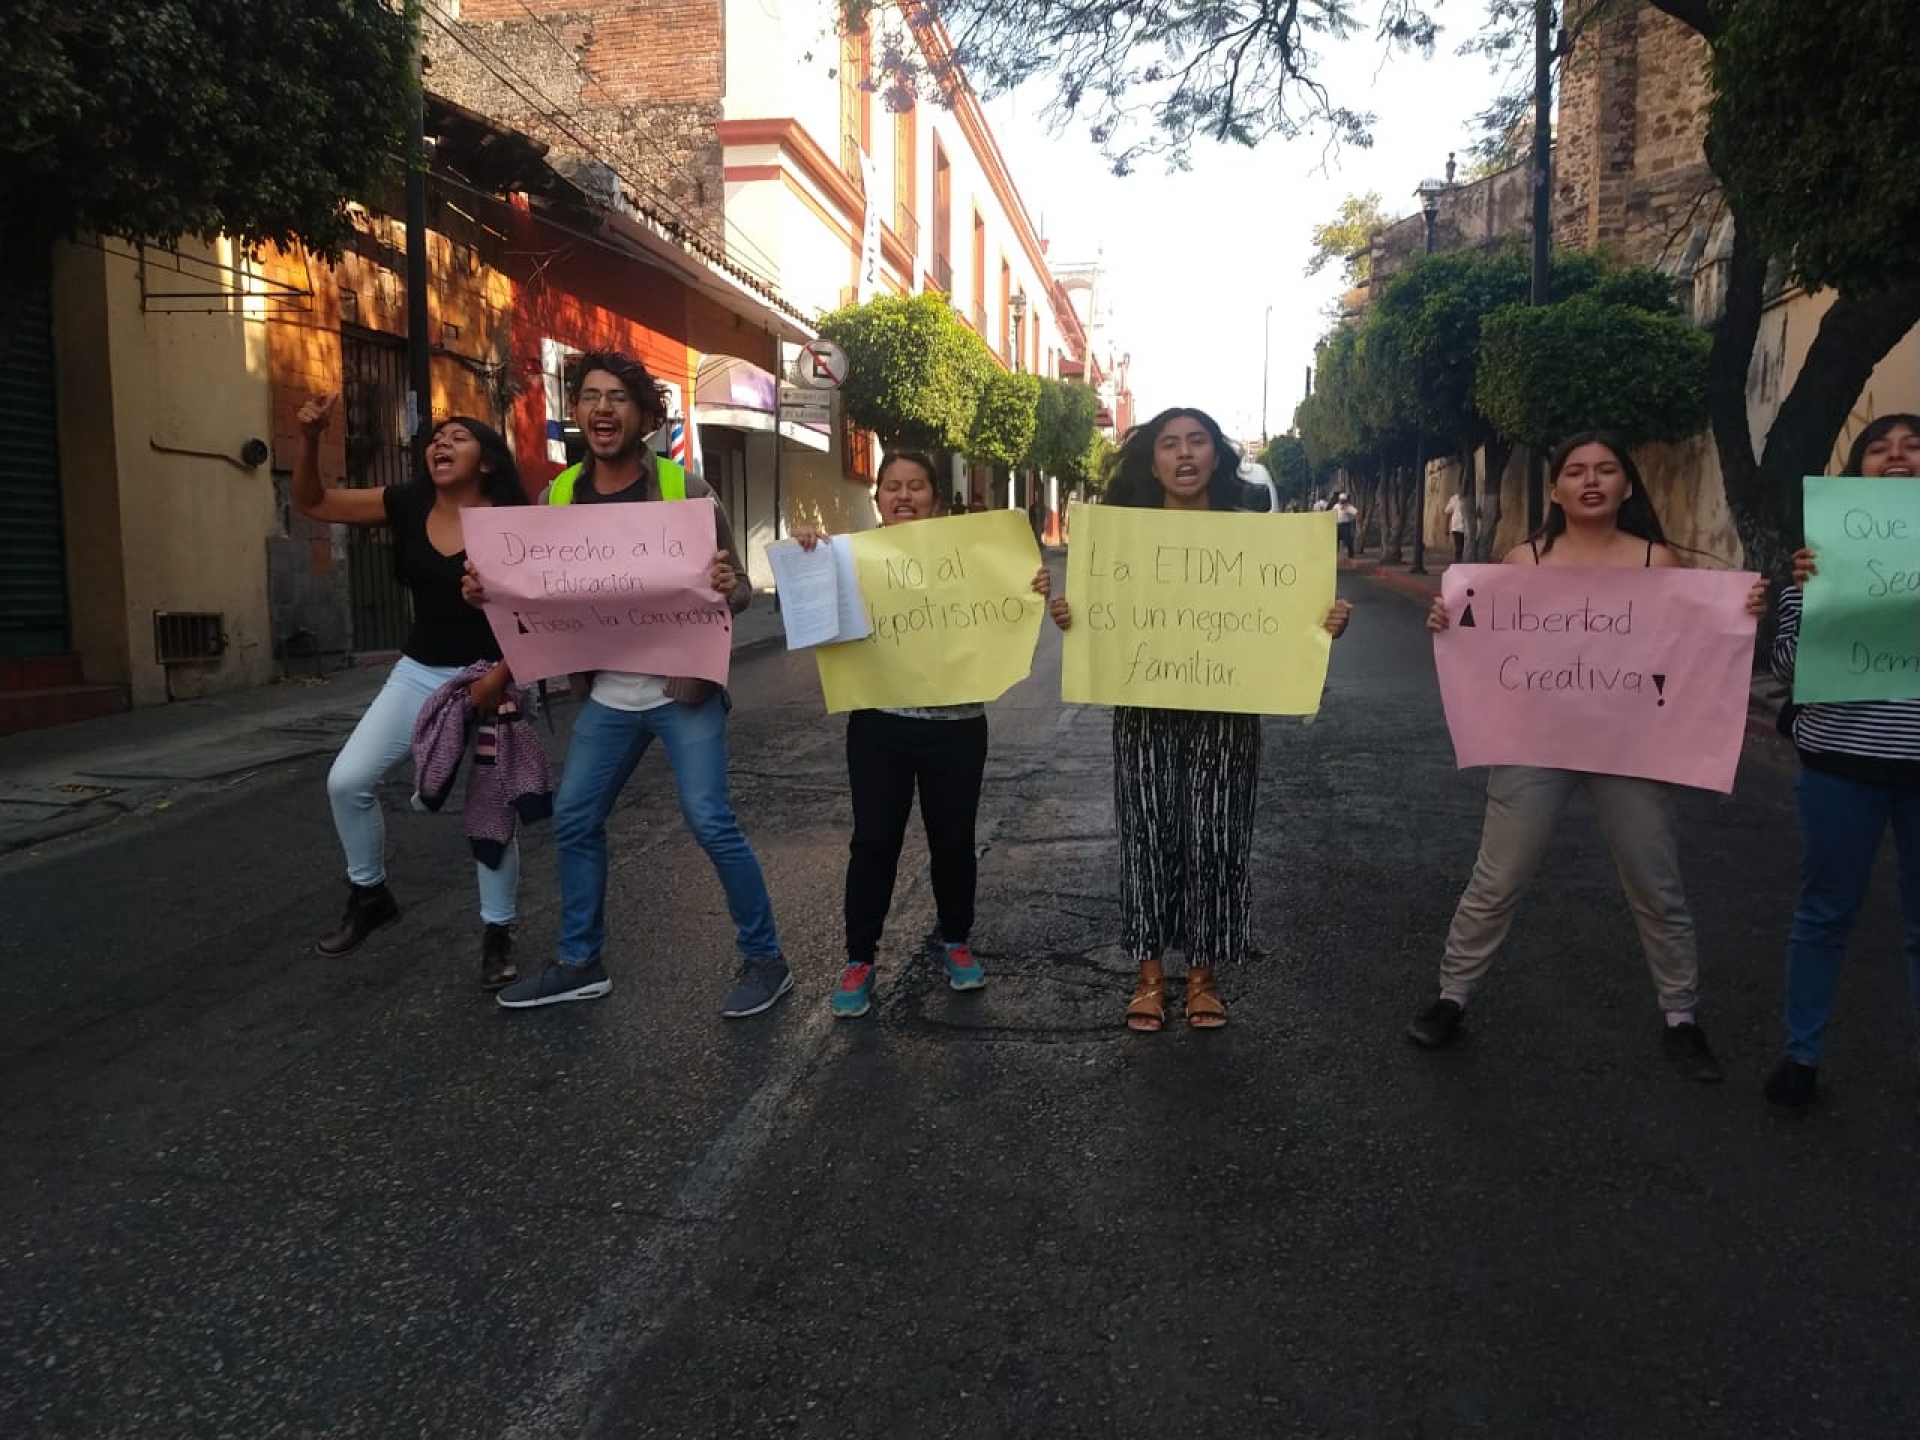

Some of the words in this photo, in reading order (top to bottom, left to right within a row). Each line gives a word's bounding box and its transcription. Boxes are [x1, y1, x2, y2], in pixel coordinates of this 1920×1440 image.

[1843, 508, 1909, 541] Que
[500, 532, 614, 566] Derecho
[632, 542, 649, 556] a
[662, 527, 685, 557] la
[1089, 541, 1130, 582] La
[1155, 544, 1244, 587] ETDM
[1259, 561, 1298, 587] no
[542, 569, 648, 597] Educación
[885, 557, 924, 590] NO
[937, 549, 967, 580] al
[870, 596, 1024, 645] epotismo
[1088, 602, 1116, 631] es
[1132, 607, 1167, 631] un
[1177, 607, 1280, 643] negocio
[1499, 654, 1666, 707] Creativa!
